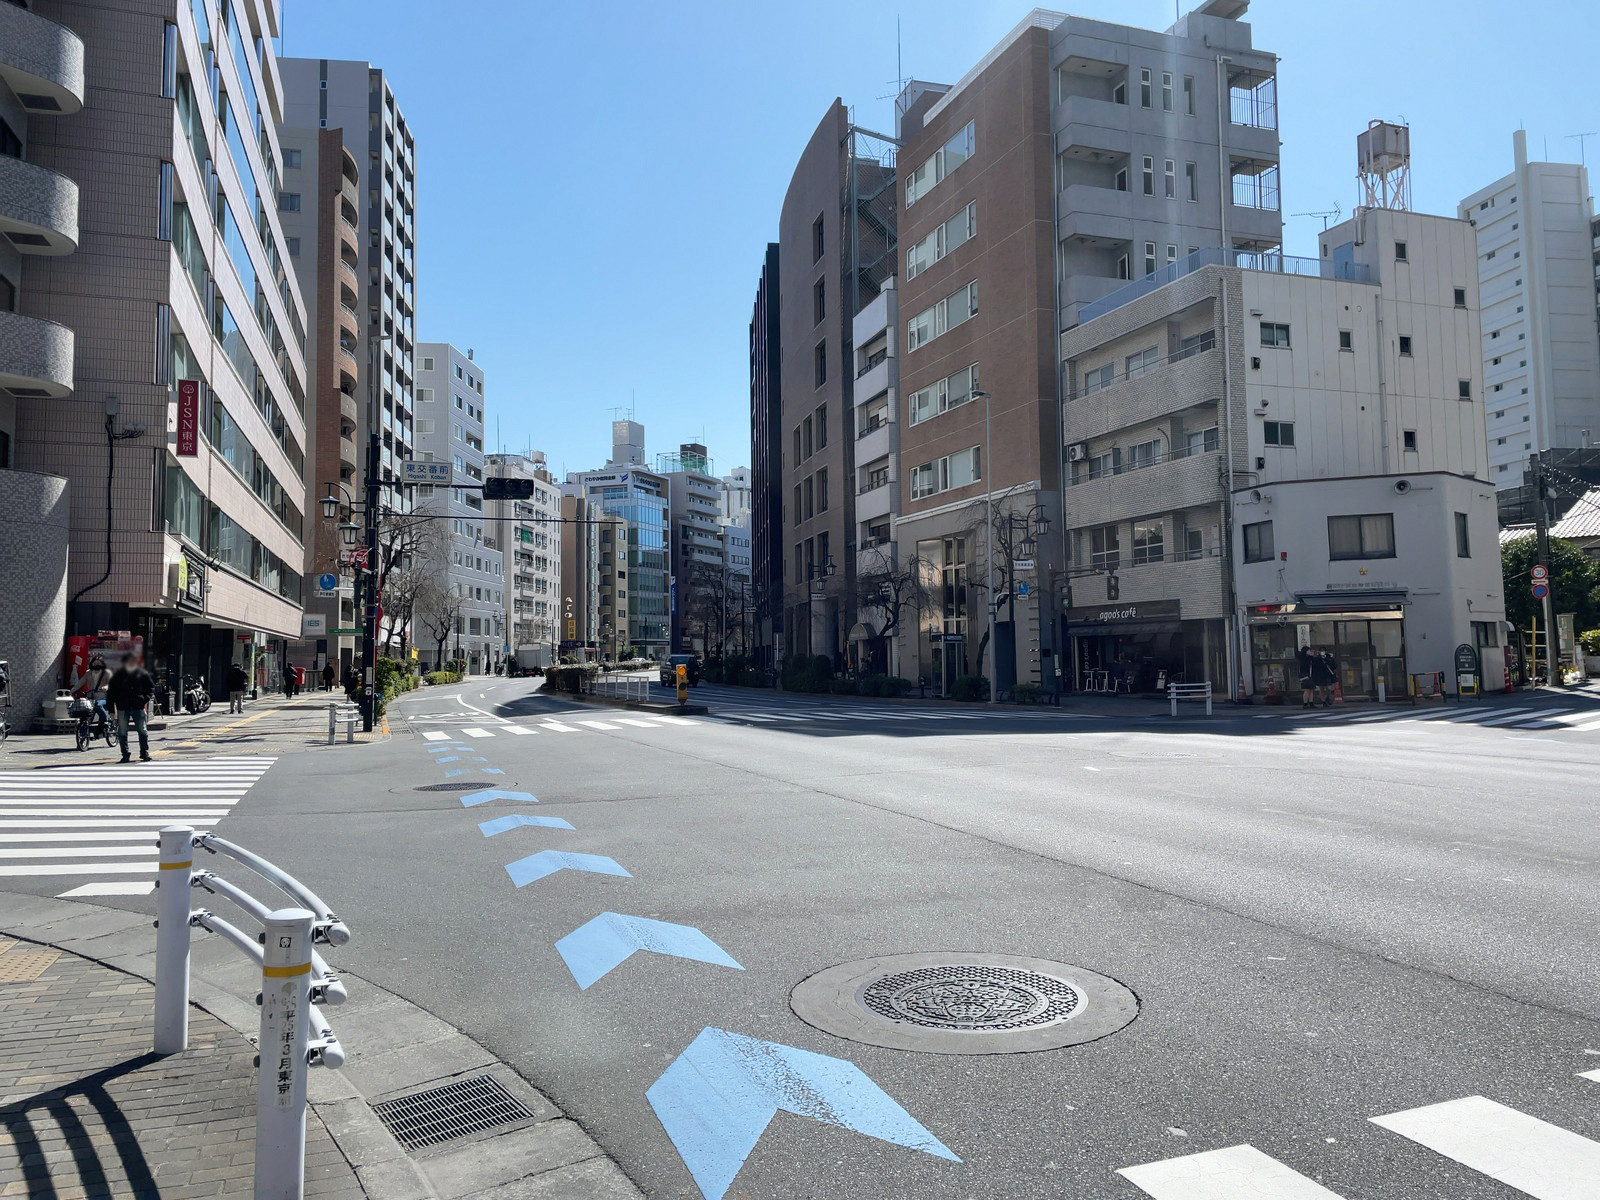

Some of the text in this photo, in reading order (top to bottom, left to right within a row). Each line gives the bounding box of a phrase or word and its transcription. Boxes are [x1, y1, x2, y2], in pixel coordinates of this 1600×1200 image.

[182, 396, 193, 451] JSN東京
[406, 464, 449, 474] 東交番前
[1100, 607, 1137, 621] agoo's café
